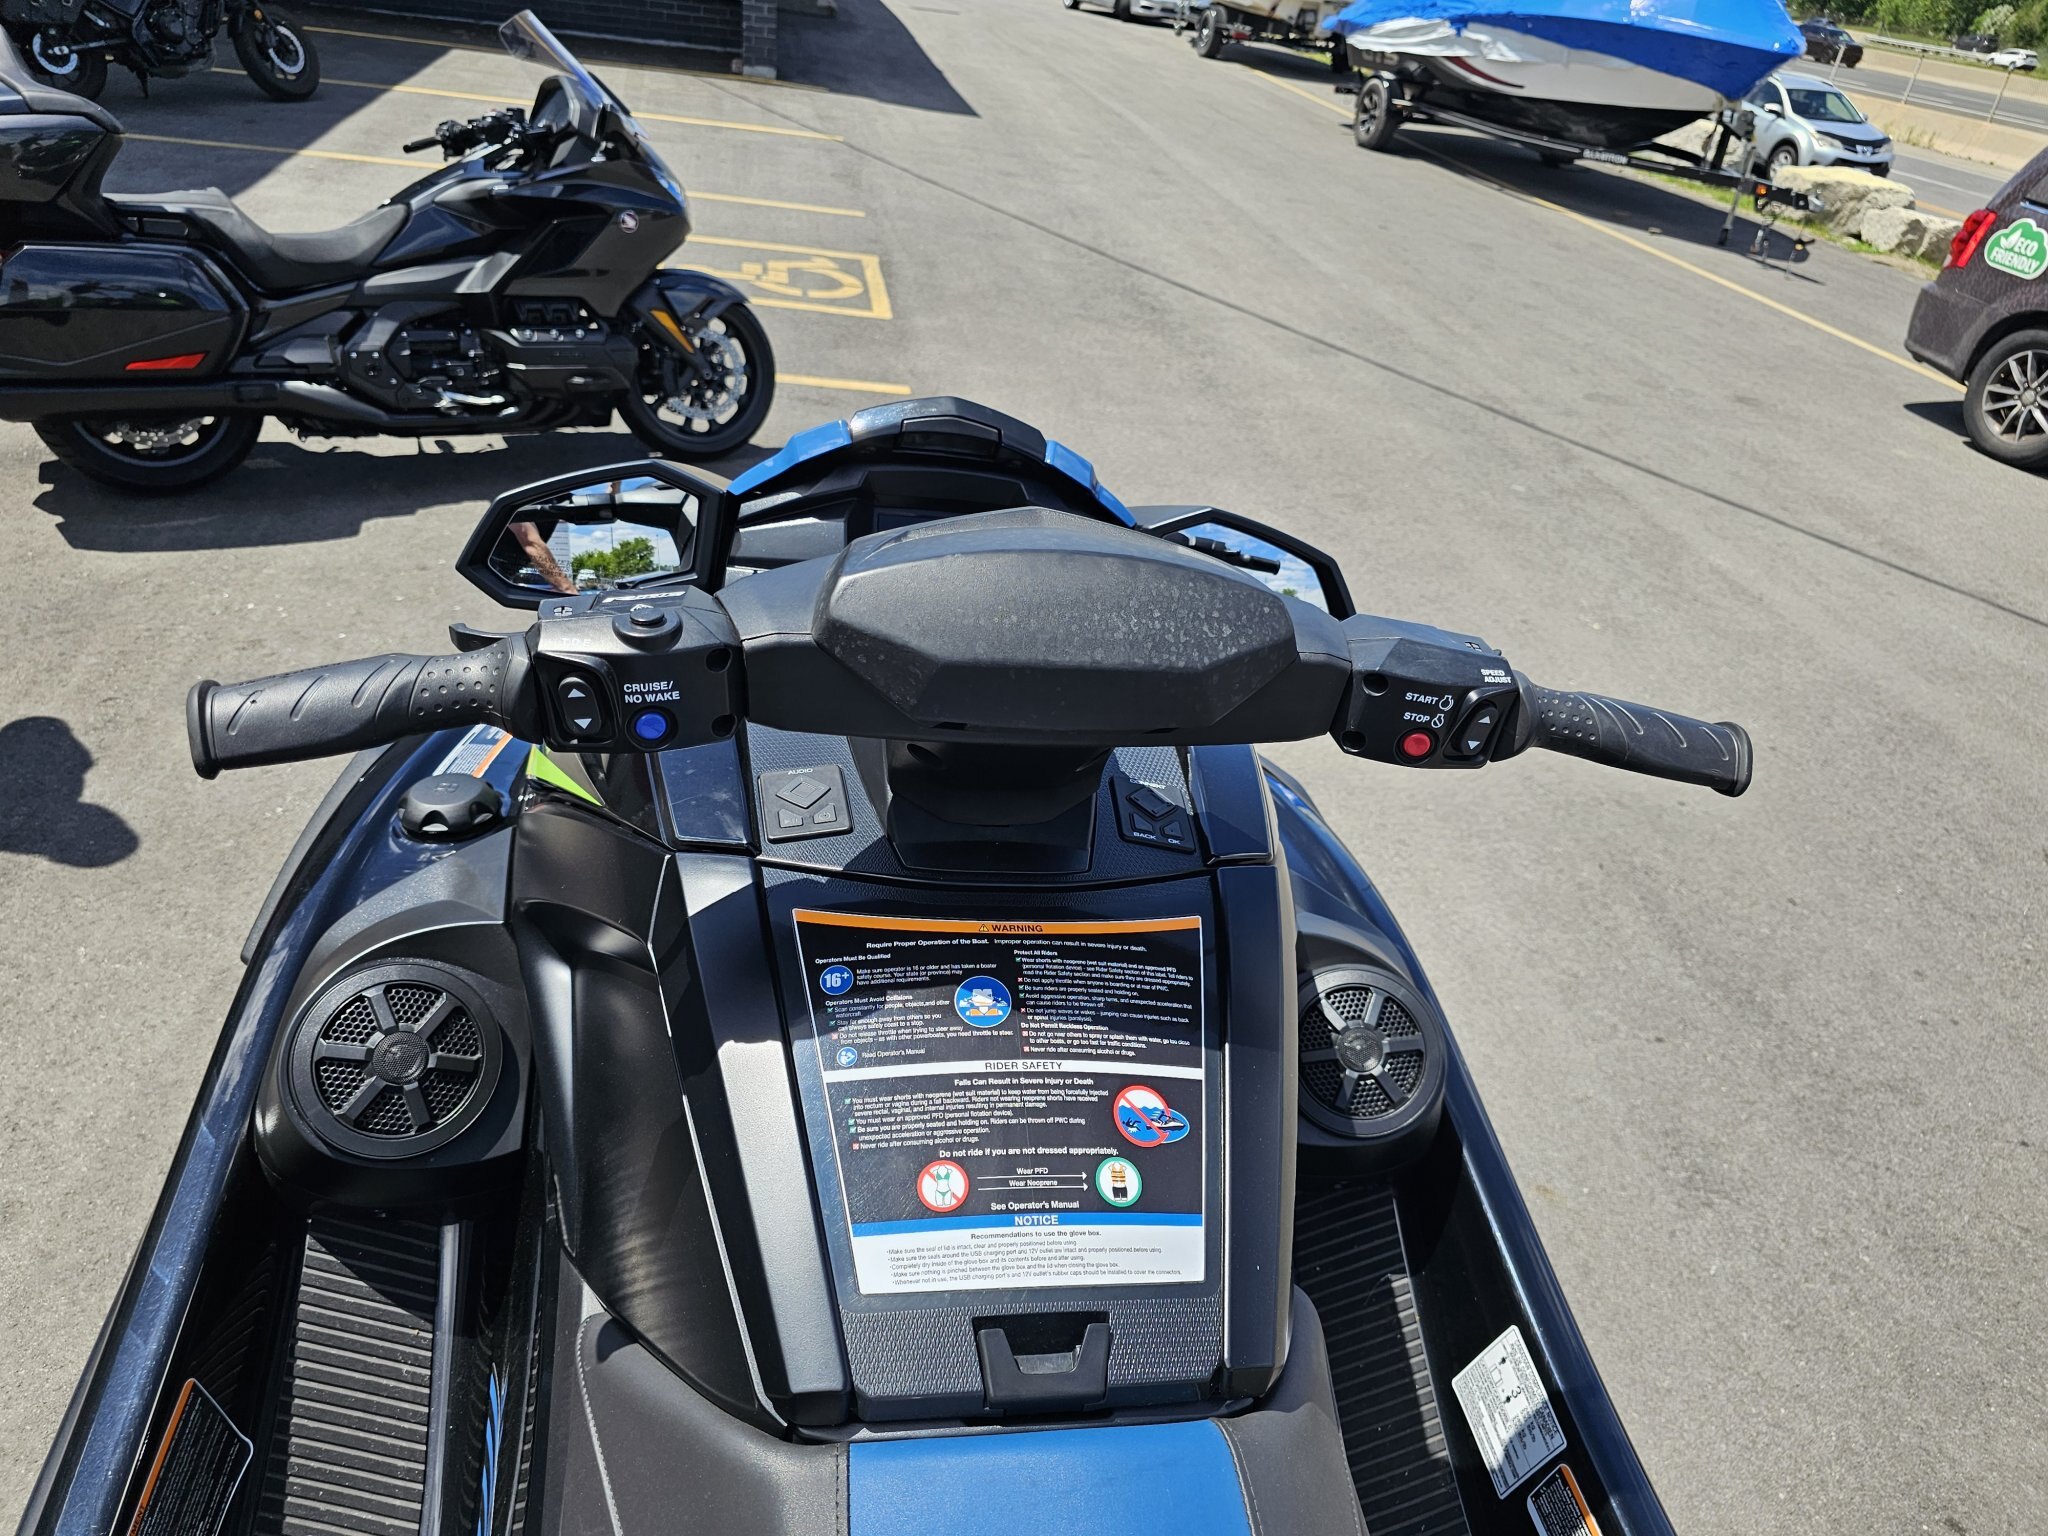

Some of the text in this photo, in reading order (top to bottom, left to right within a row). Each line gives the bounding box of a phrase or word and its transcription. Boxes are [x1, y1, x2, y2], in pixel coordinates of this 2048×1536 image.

[2013, 237, 2039, 257] ECO
[1990, 246, 2040, 274] FRIENDLY
[1480, 668, 1505, 676] SPEED
[624, 680, 673, 694] CRUISE/
[625, 690, 680, 704] NO WAKE
[1405, 692, 1438, 704] START
[1403, 712, 1430, 723] STOP
[824, 972, 850, 988] 16+
[825, 998, 853, 1006] Operators
[877, 1049, 905, 1057] Operator's
[1022, 1062, 1062, 1070] SAFETY
[1069, 1147, 1119, 1155] appropriately.
[1008, 1201, 1050, 1211] Operator's
[1051, 1201, 1080, 1209] Manual
[1015, 1215, 1059, 1225] NOTICE
